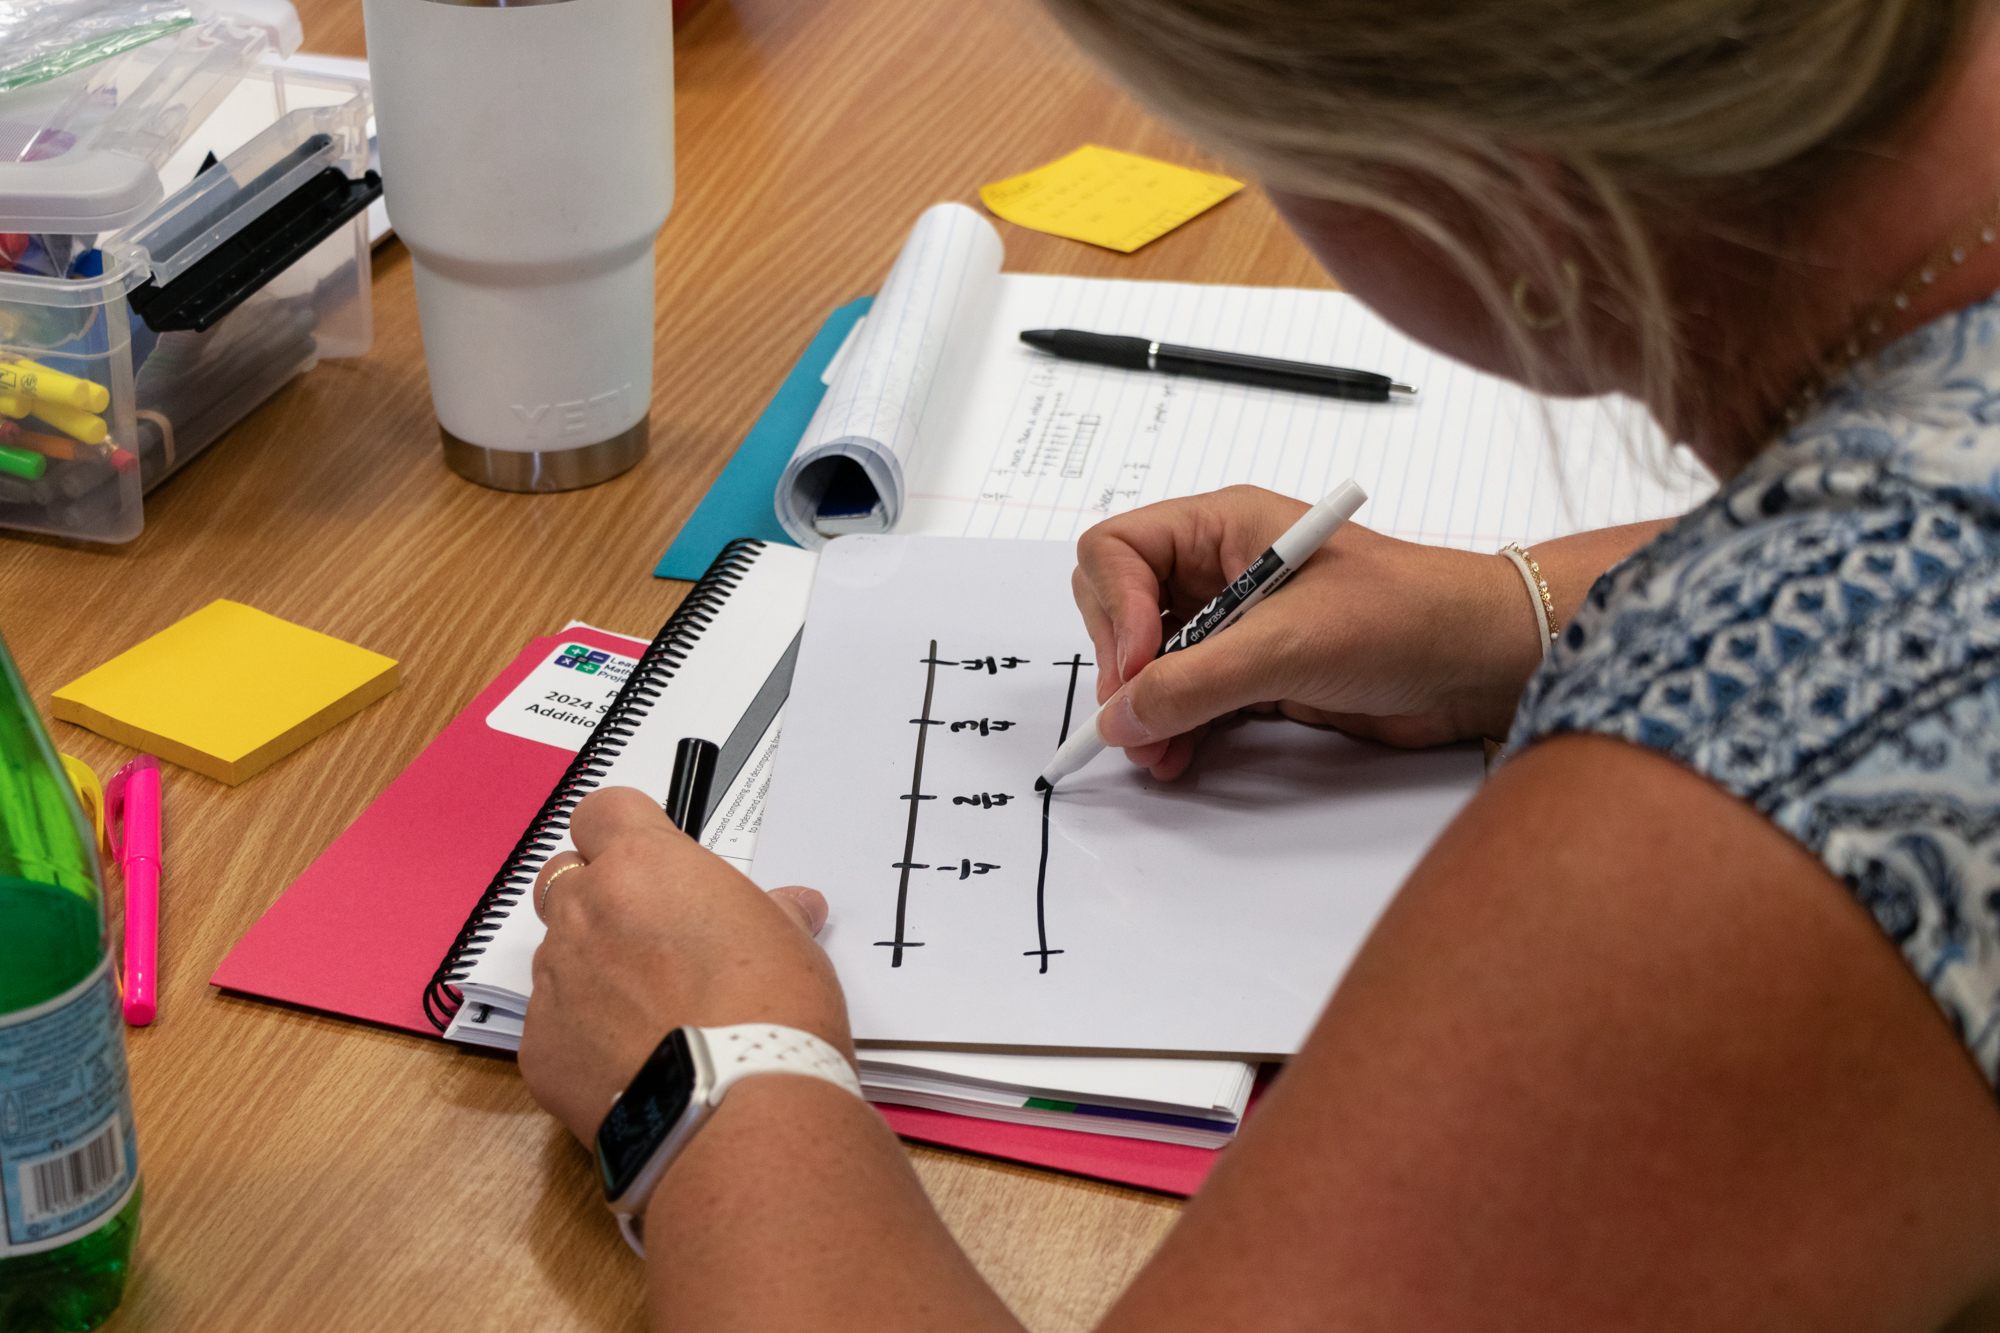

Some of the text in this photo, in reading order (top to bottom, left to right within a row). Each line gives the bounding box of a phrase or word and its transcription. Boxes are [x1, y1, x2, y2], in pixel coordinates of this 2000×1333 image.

[510, 382, 632, 440] YETI
[1248, 557, 1264, 573] fine
[1190, 607, 1227, 642] dry erase
[545, 691, 594, 710] 2024
[704, 817, 731, 851] Understand
[726, 788, 751, 818] composing
[751, 743, 779, 779] decomposing
[734, 799, 761, 832] Understand
